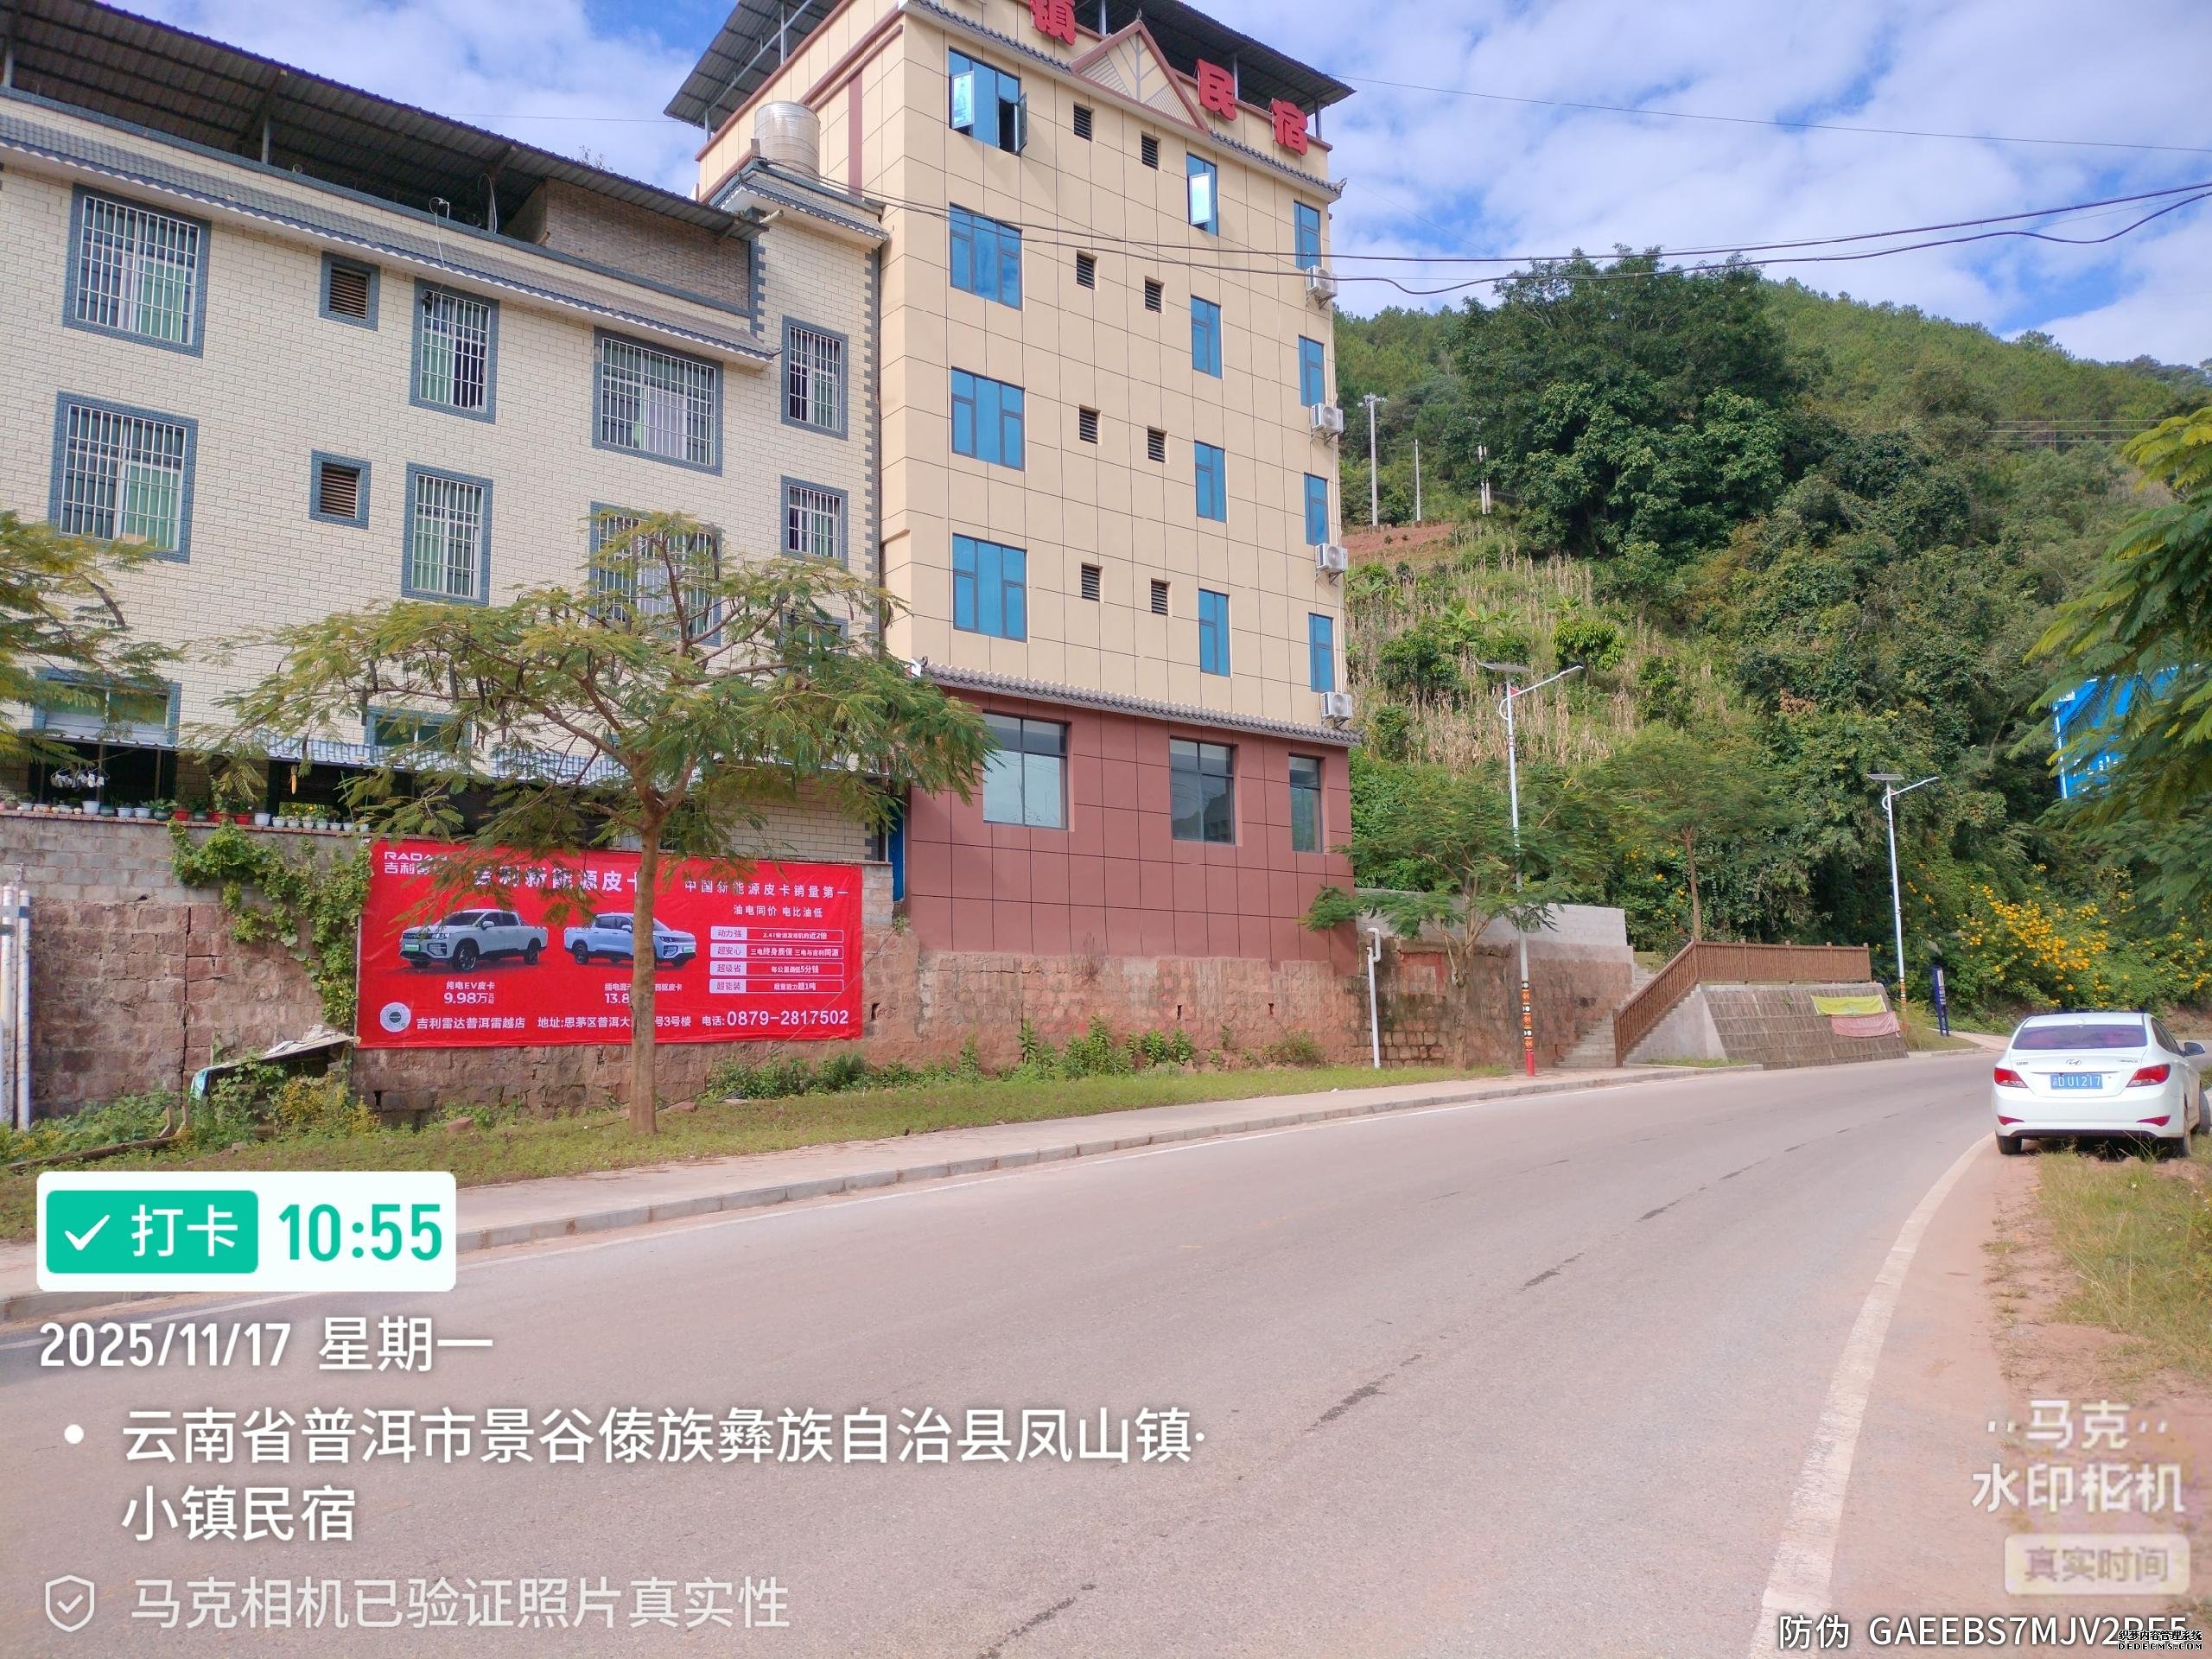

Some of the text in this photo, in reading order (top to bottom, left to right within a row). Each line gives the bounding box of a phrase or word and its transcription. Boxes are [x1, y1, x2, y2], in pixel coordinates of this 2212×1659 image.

[1197, 59, 1308, 156] 民宿
[384, 851, 448, 861] RADA
[384, 862, 444, 874] 吉利
[684, 879, 849, 899] 中国新能源皮卡销量第一
[733, 905, 823, 918] 油电同价 电比油低
[717, 929, 742, 938] 动力强
[717, 946, 742, 956] 超安心
[717, 963, 742, 973] 超级省
[446, 981, 496, 991] 纯电EV皮卡
[716, 982, 742, 991] 超能装
[416, 1016, 526, 1030] 吉利雷达普洱雷越店
[537, 1016, 632, 1028] 地址:思茅区普洱大
[727, 1009, 849, 1027] 0879-2817502
